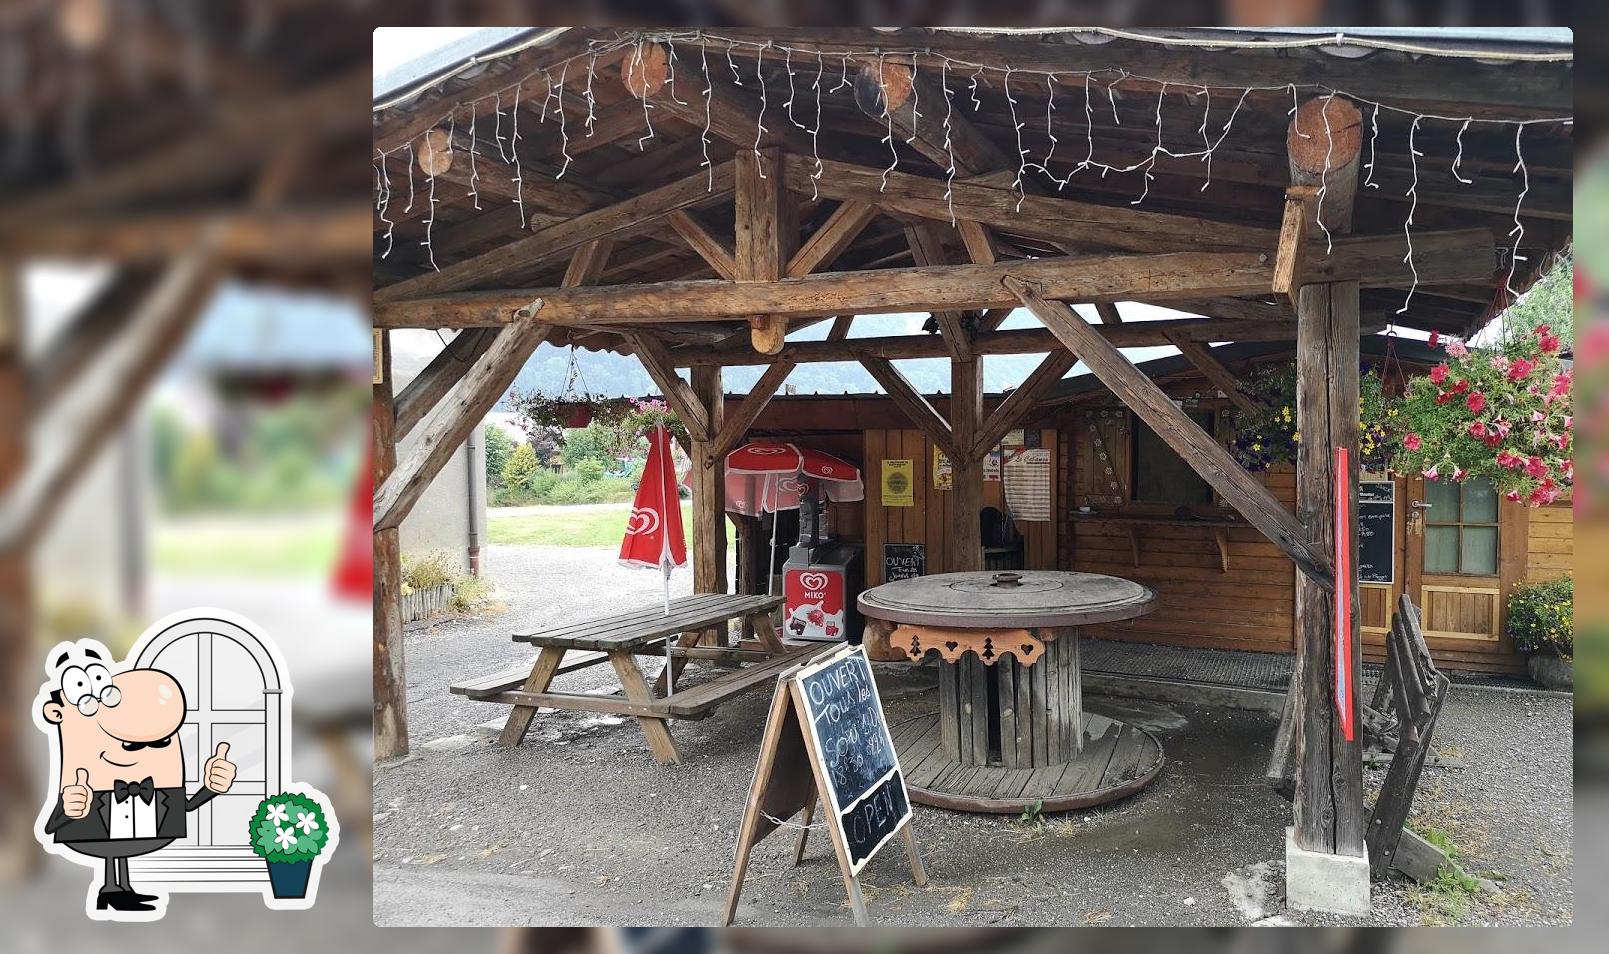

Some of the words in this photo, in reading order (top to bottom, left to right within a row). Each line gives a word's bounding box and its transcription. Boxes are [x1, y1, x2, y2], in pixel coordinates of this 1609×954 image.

[885, 556, 920, 567] OUVERT
[804, 591, 824, 600] MIKO
[810, 656, 865, 705] OUVERT
[853, 784, 898, 844] OPEN
